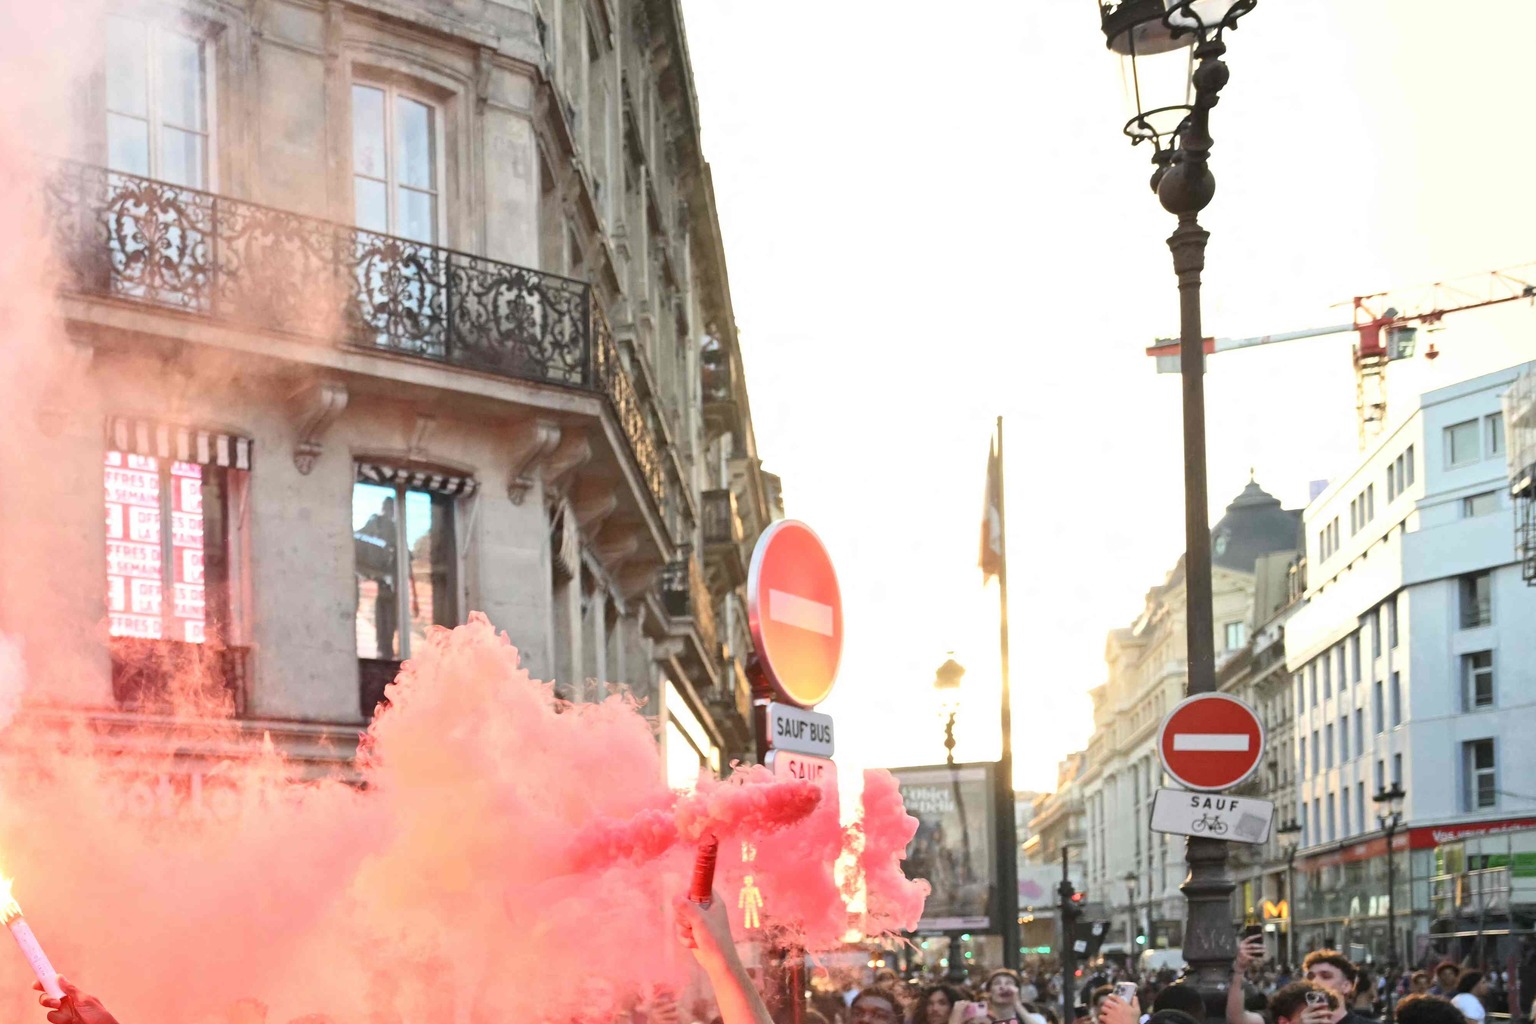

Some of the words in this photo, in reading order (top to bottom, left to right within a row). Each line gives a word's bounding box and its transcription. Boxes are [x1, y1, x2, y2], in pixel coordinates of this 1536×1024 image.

[777, 716, 808, 739] SAUF
[810, 723, 831, 743] BUS
[1191, 796, 1239, 812] SAUF
